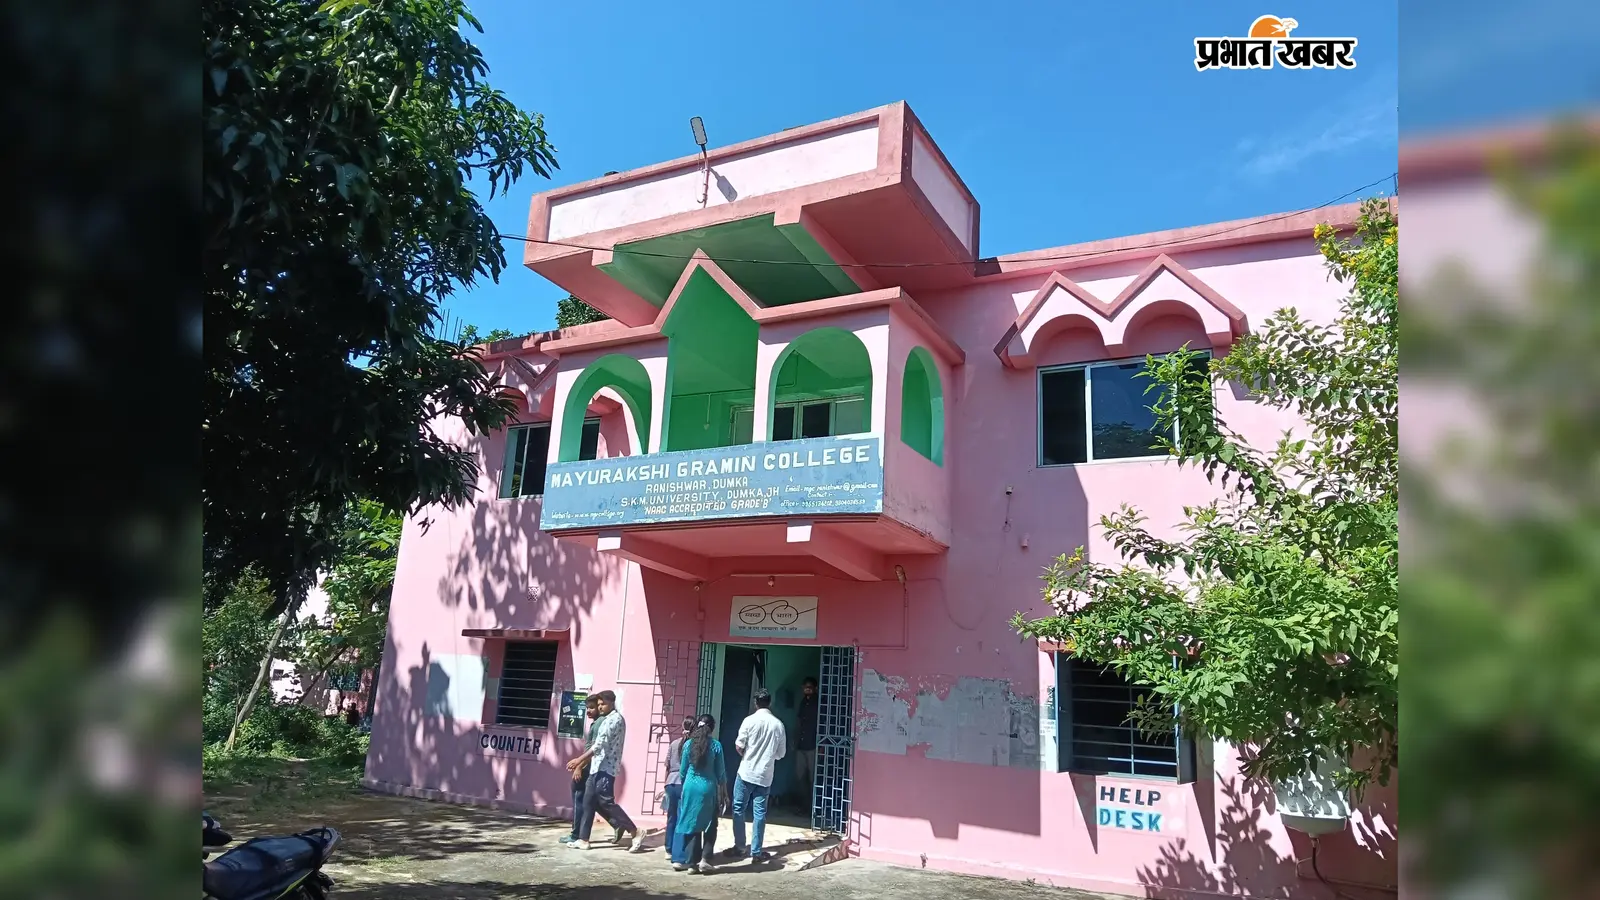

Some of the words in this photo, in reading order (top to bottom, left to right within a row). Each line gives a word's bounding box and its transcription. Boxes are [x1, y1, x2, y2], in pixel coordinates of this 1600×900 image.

[551, 463, 670, 488] MAYURAKSHI
[677, 455, 756, 477] GRAMIN
[763, 445, 871, 470] COLLEGE
[713, 477, 748, 489] DUMKA
[480, 733, 541, 755] COUNTER
[1100, 785, 1161, 806] HELP
[1099, 808, 1162, 832] DESK
